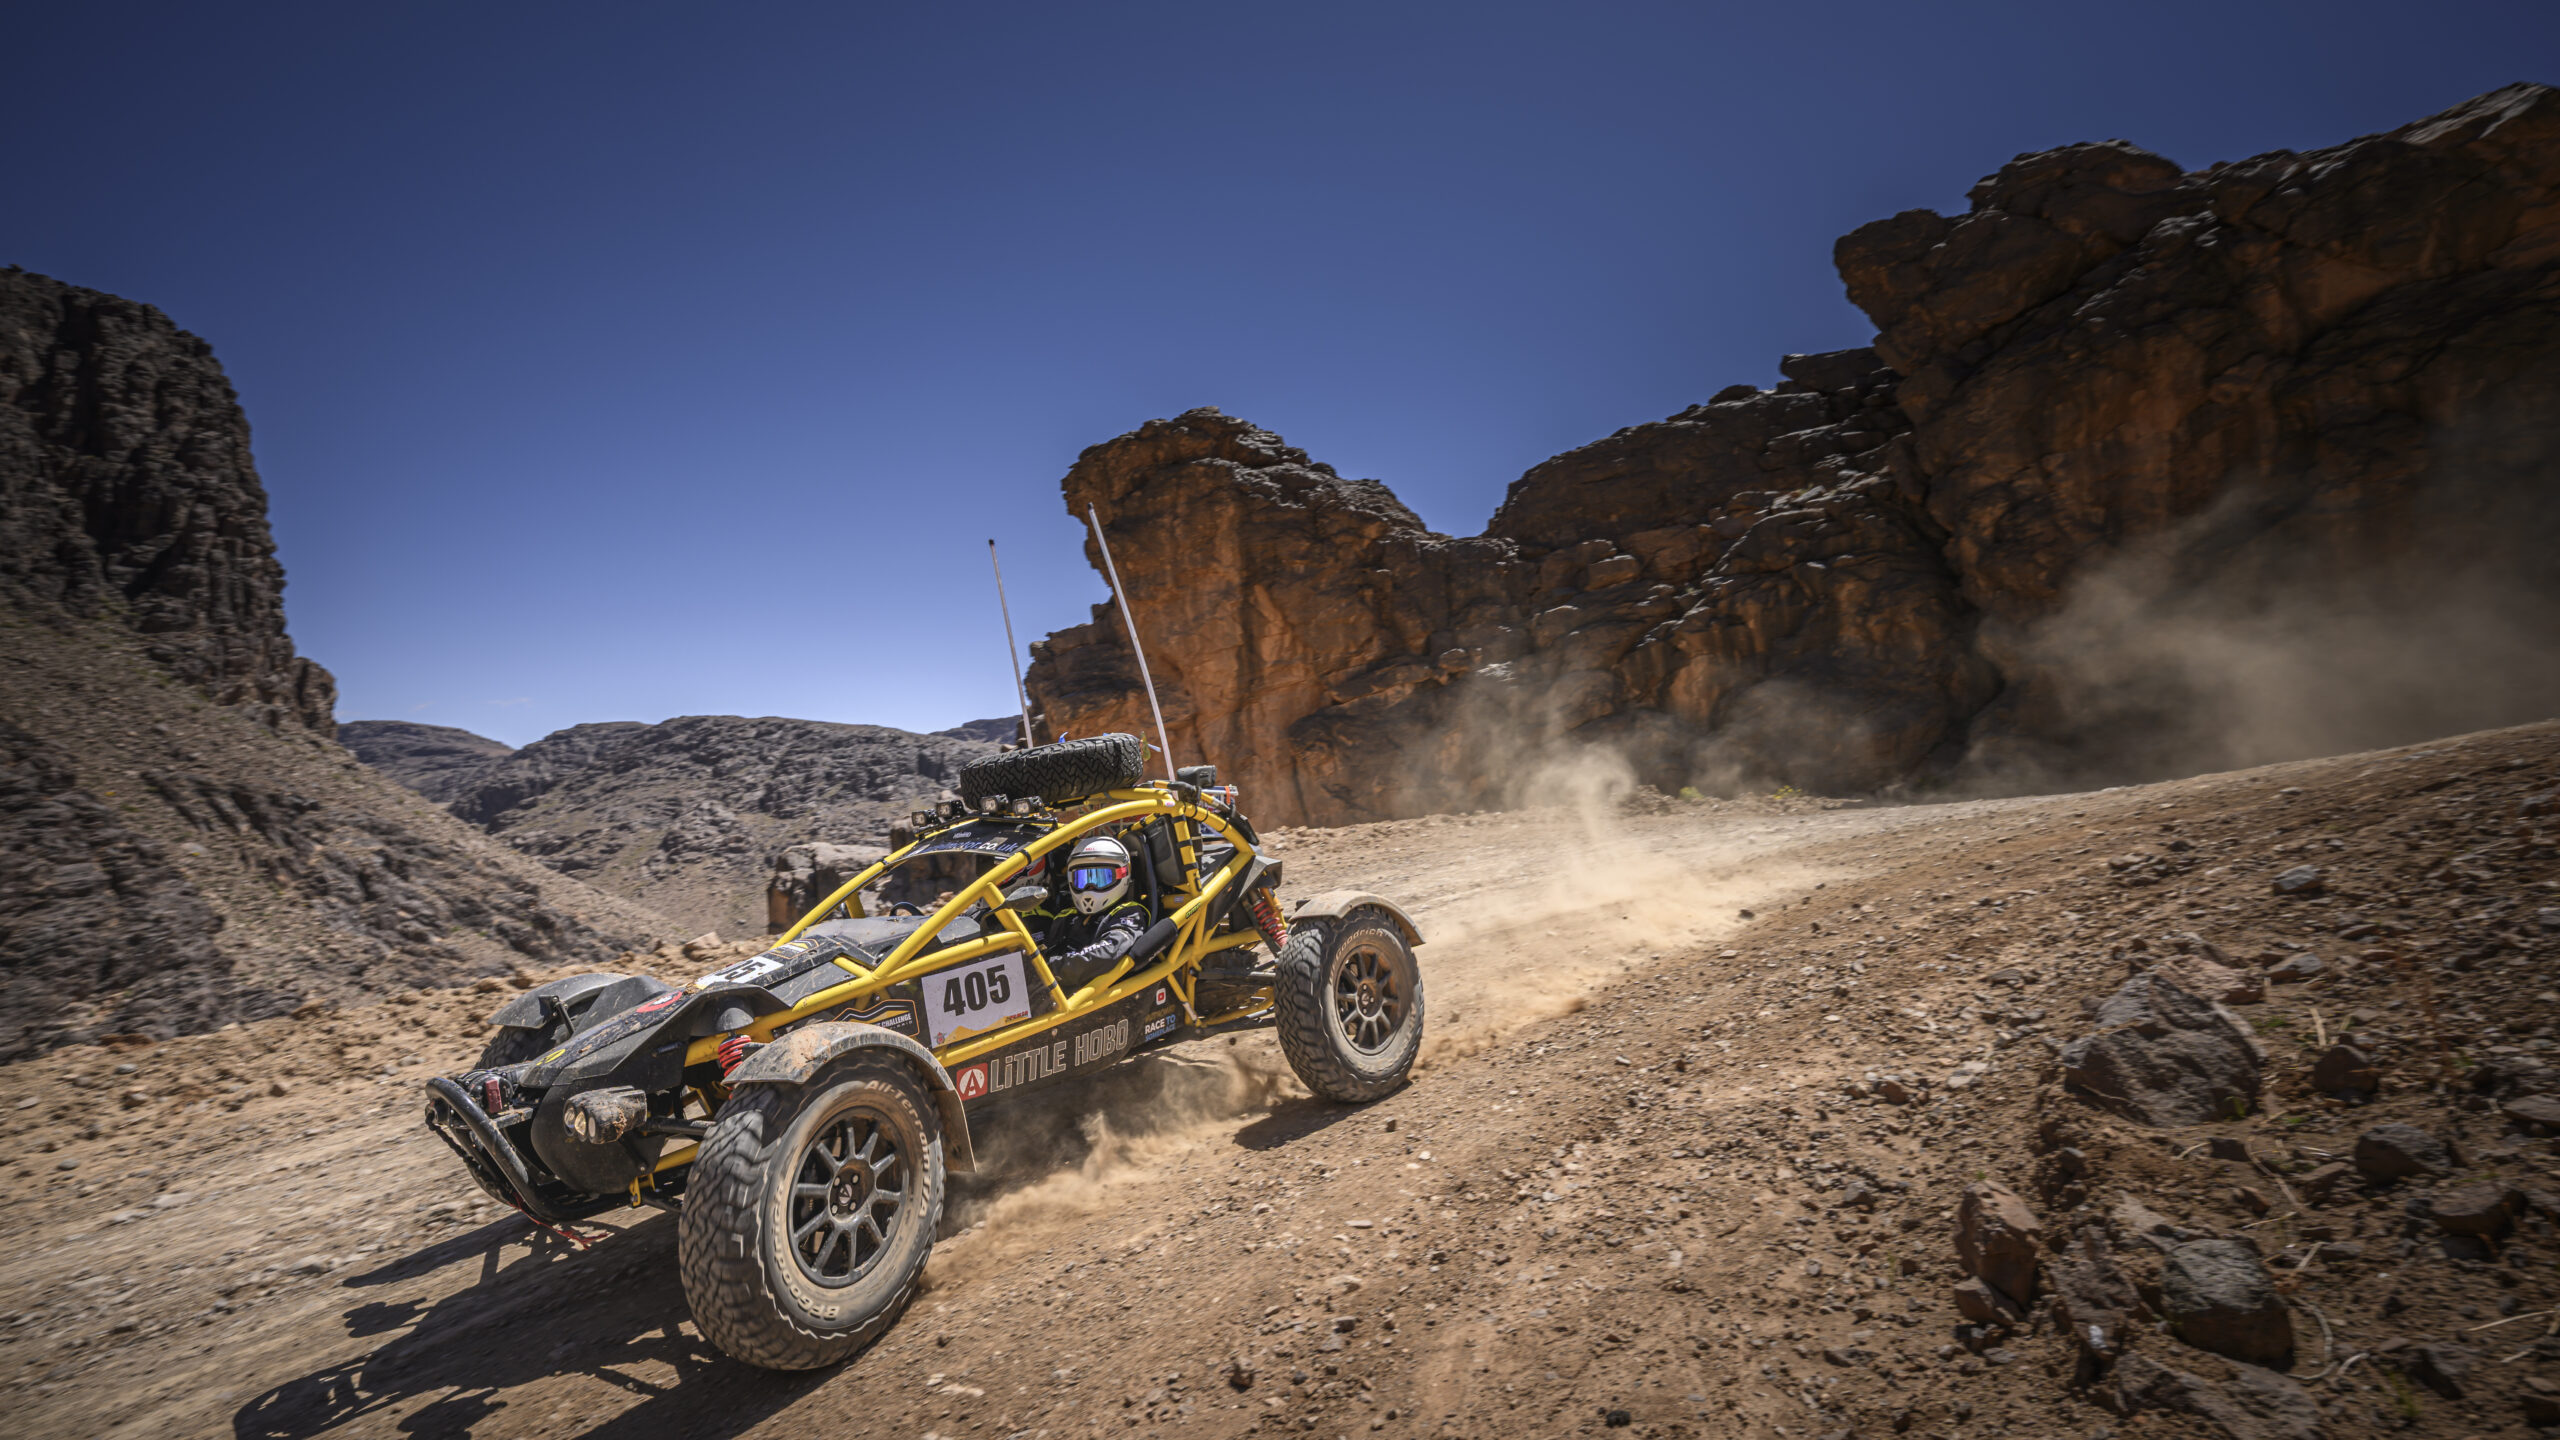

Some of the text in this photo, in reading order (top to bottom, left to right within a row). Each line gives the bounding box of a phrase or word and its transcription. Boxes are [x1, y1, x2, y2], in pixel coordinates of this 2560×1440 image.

[943, 964, 1010, 1016] 405
[881, 1012, 912, 1028] CHALLENGE
[1145, 1014, 1176, 1034] RACE TO
[1075, 1018, 1129, 1067] HOBO
